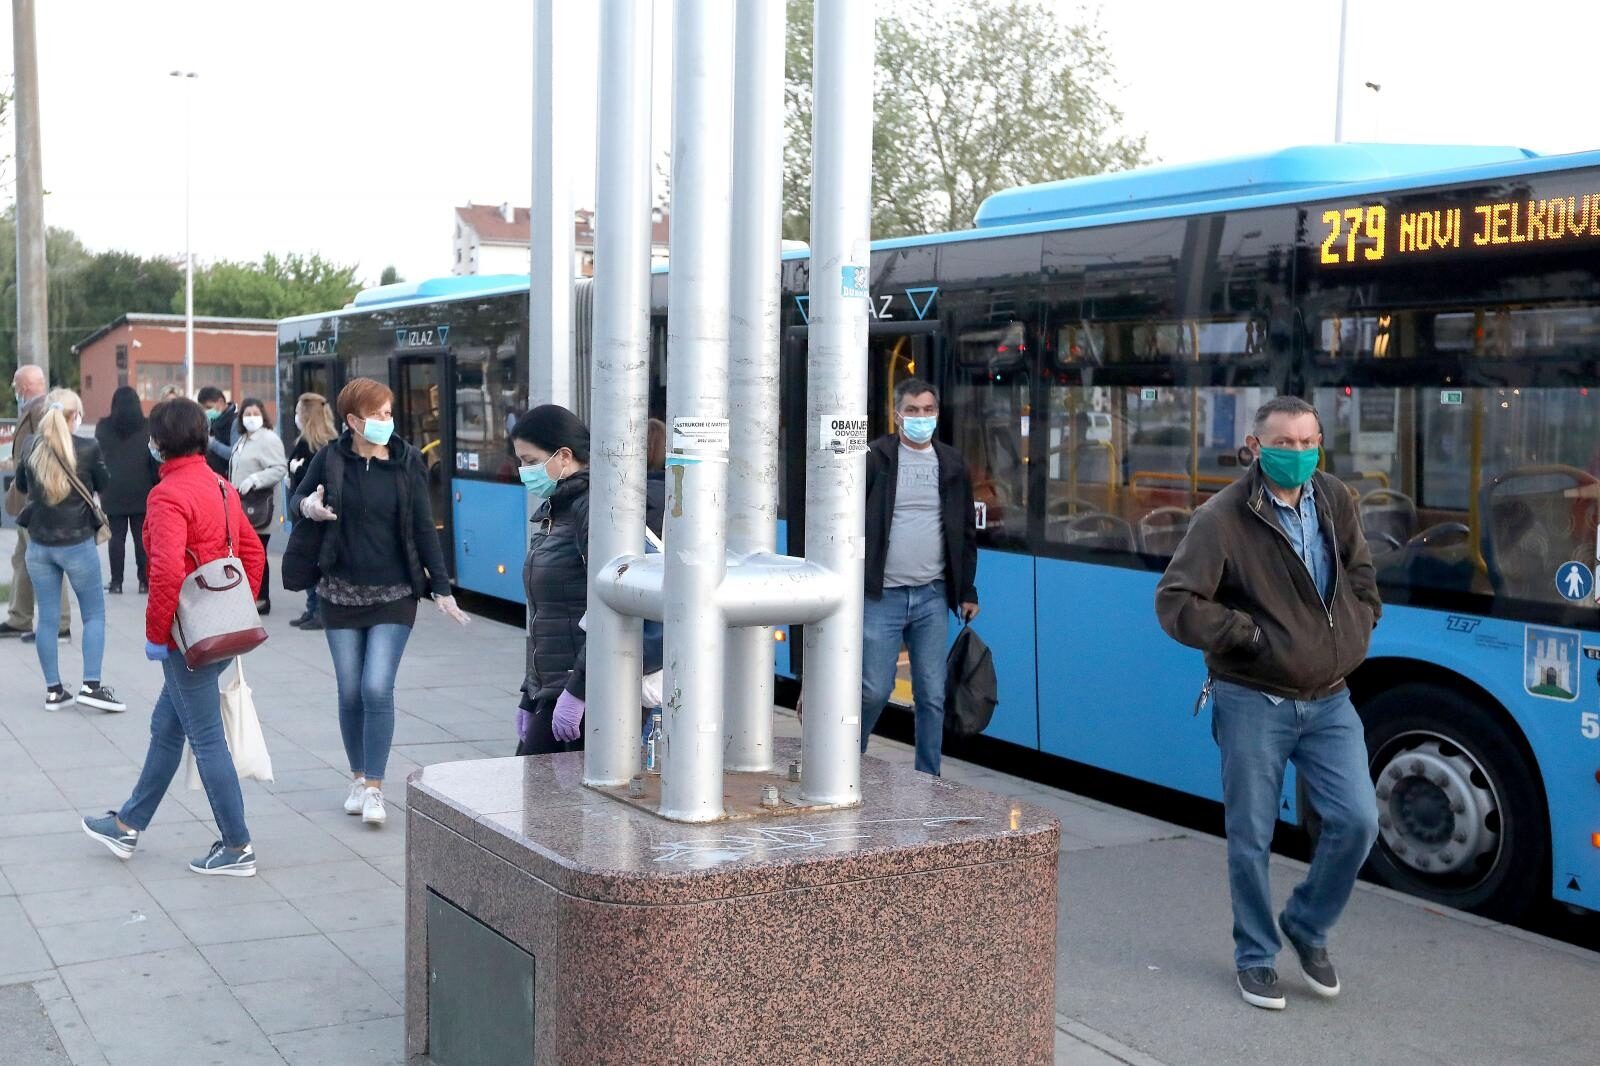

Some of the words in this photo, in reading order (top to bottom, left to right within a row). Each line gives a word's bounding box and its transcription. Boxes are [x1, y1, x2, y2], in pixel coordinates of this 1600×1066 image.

[1320, 205, 1386, 264] 279
[1399, 208, 1461, 253] NOVI
[408, 330, 433, 346] IZLAZ
[308, 340, 326, 354] IZLAZ
[1447, 615, 1481, 633] ZET
